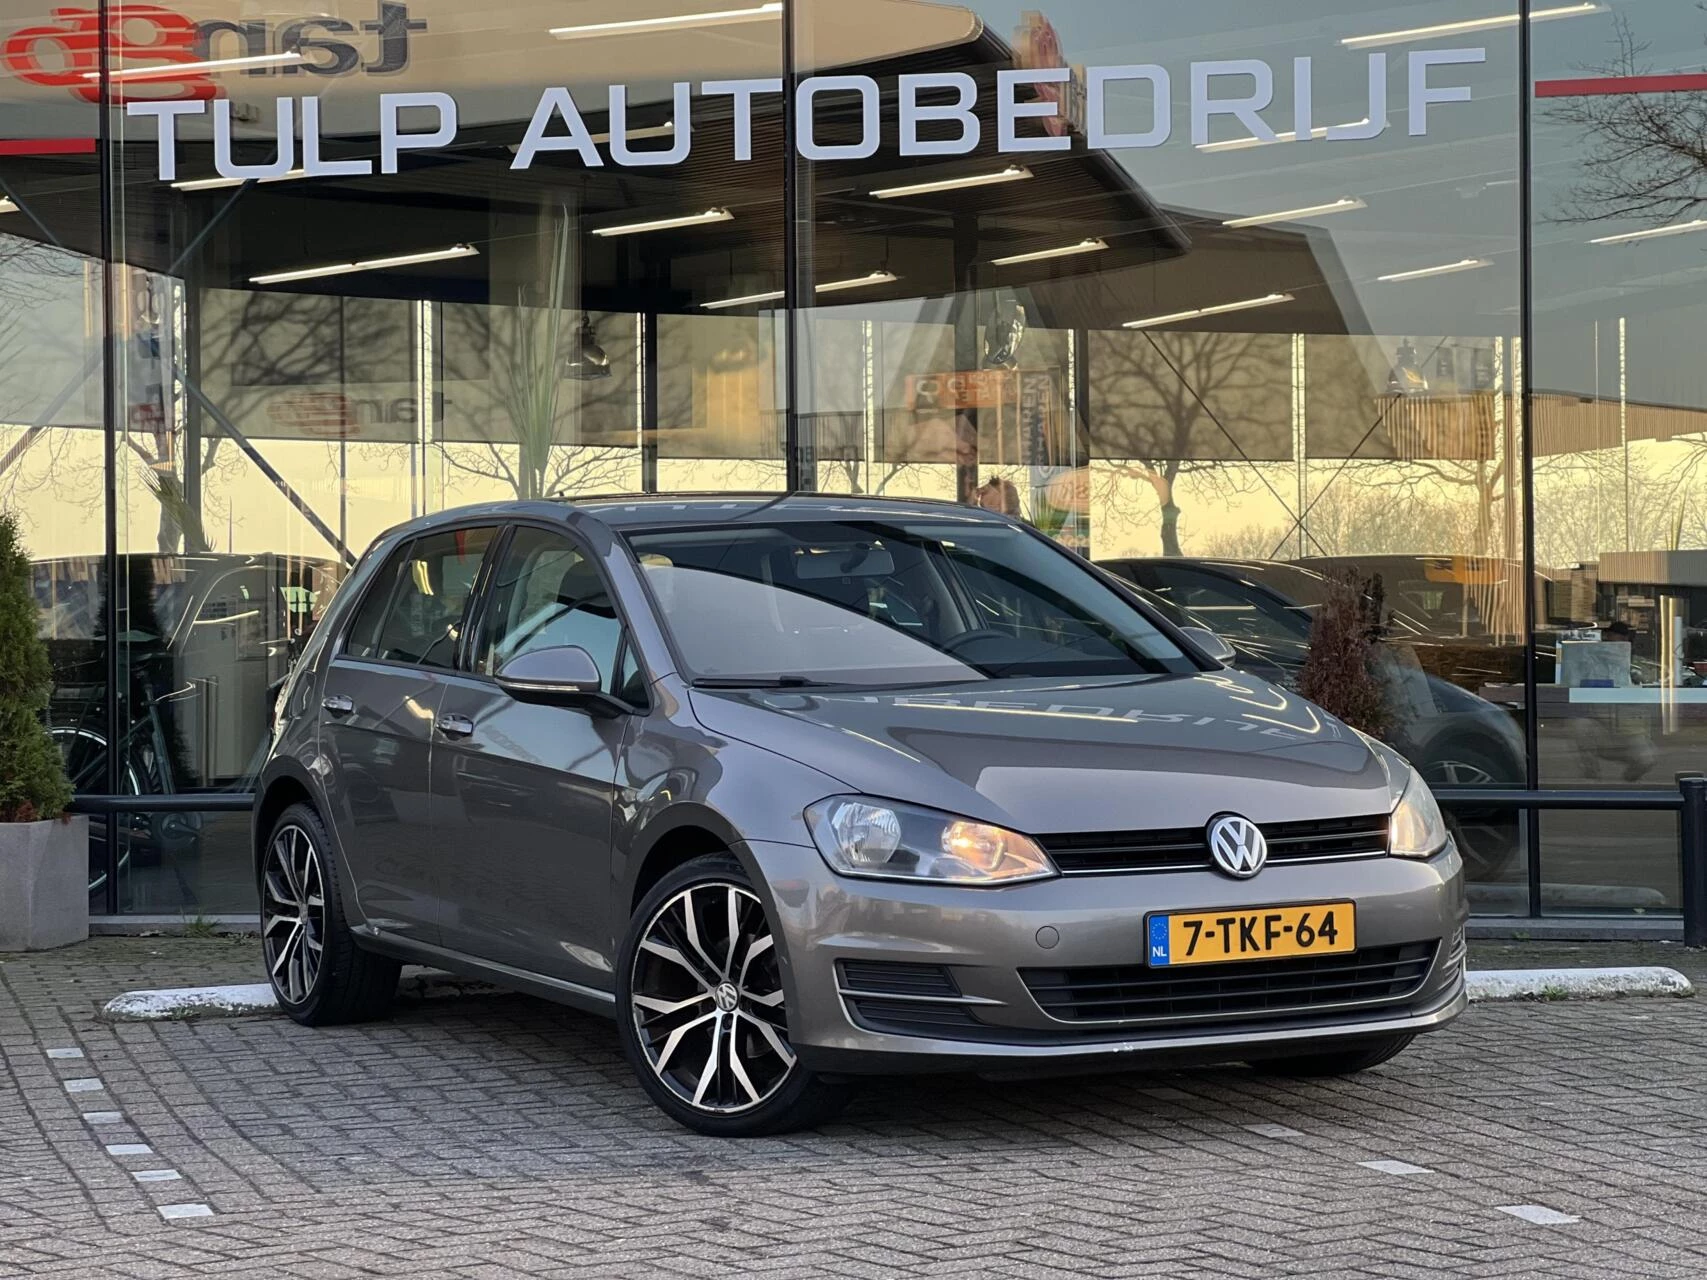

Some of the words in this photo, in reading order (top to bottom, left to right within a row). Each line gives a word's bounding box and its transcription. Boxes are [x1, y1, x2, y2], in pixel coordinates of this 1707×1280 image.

[126, 91, 459, 182] TULP
[510, 47, 1487, 171] AUTOBEDRIJF
[1152, 946, 1167, 958] NL
[1183, 910, 1338, 957] 7-TKF-64
